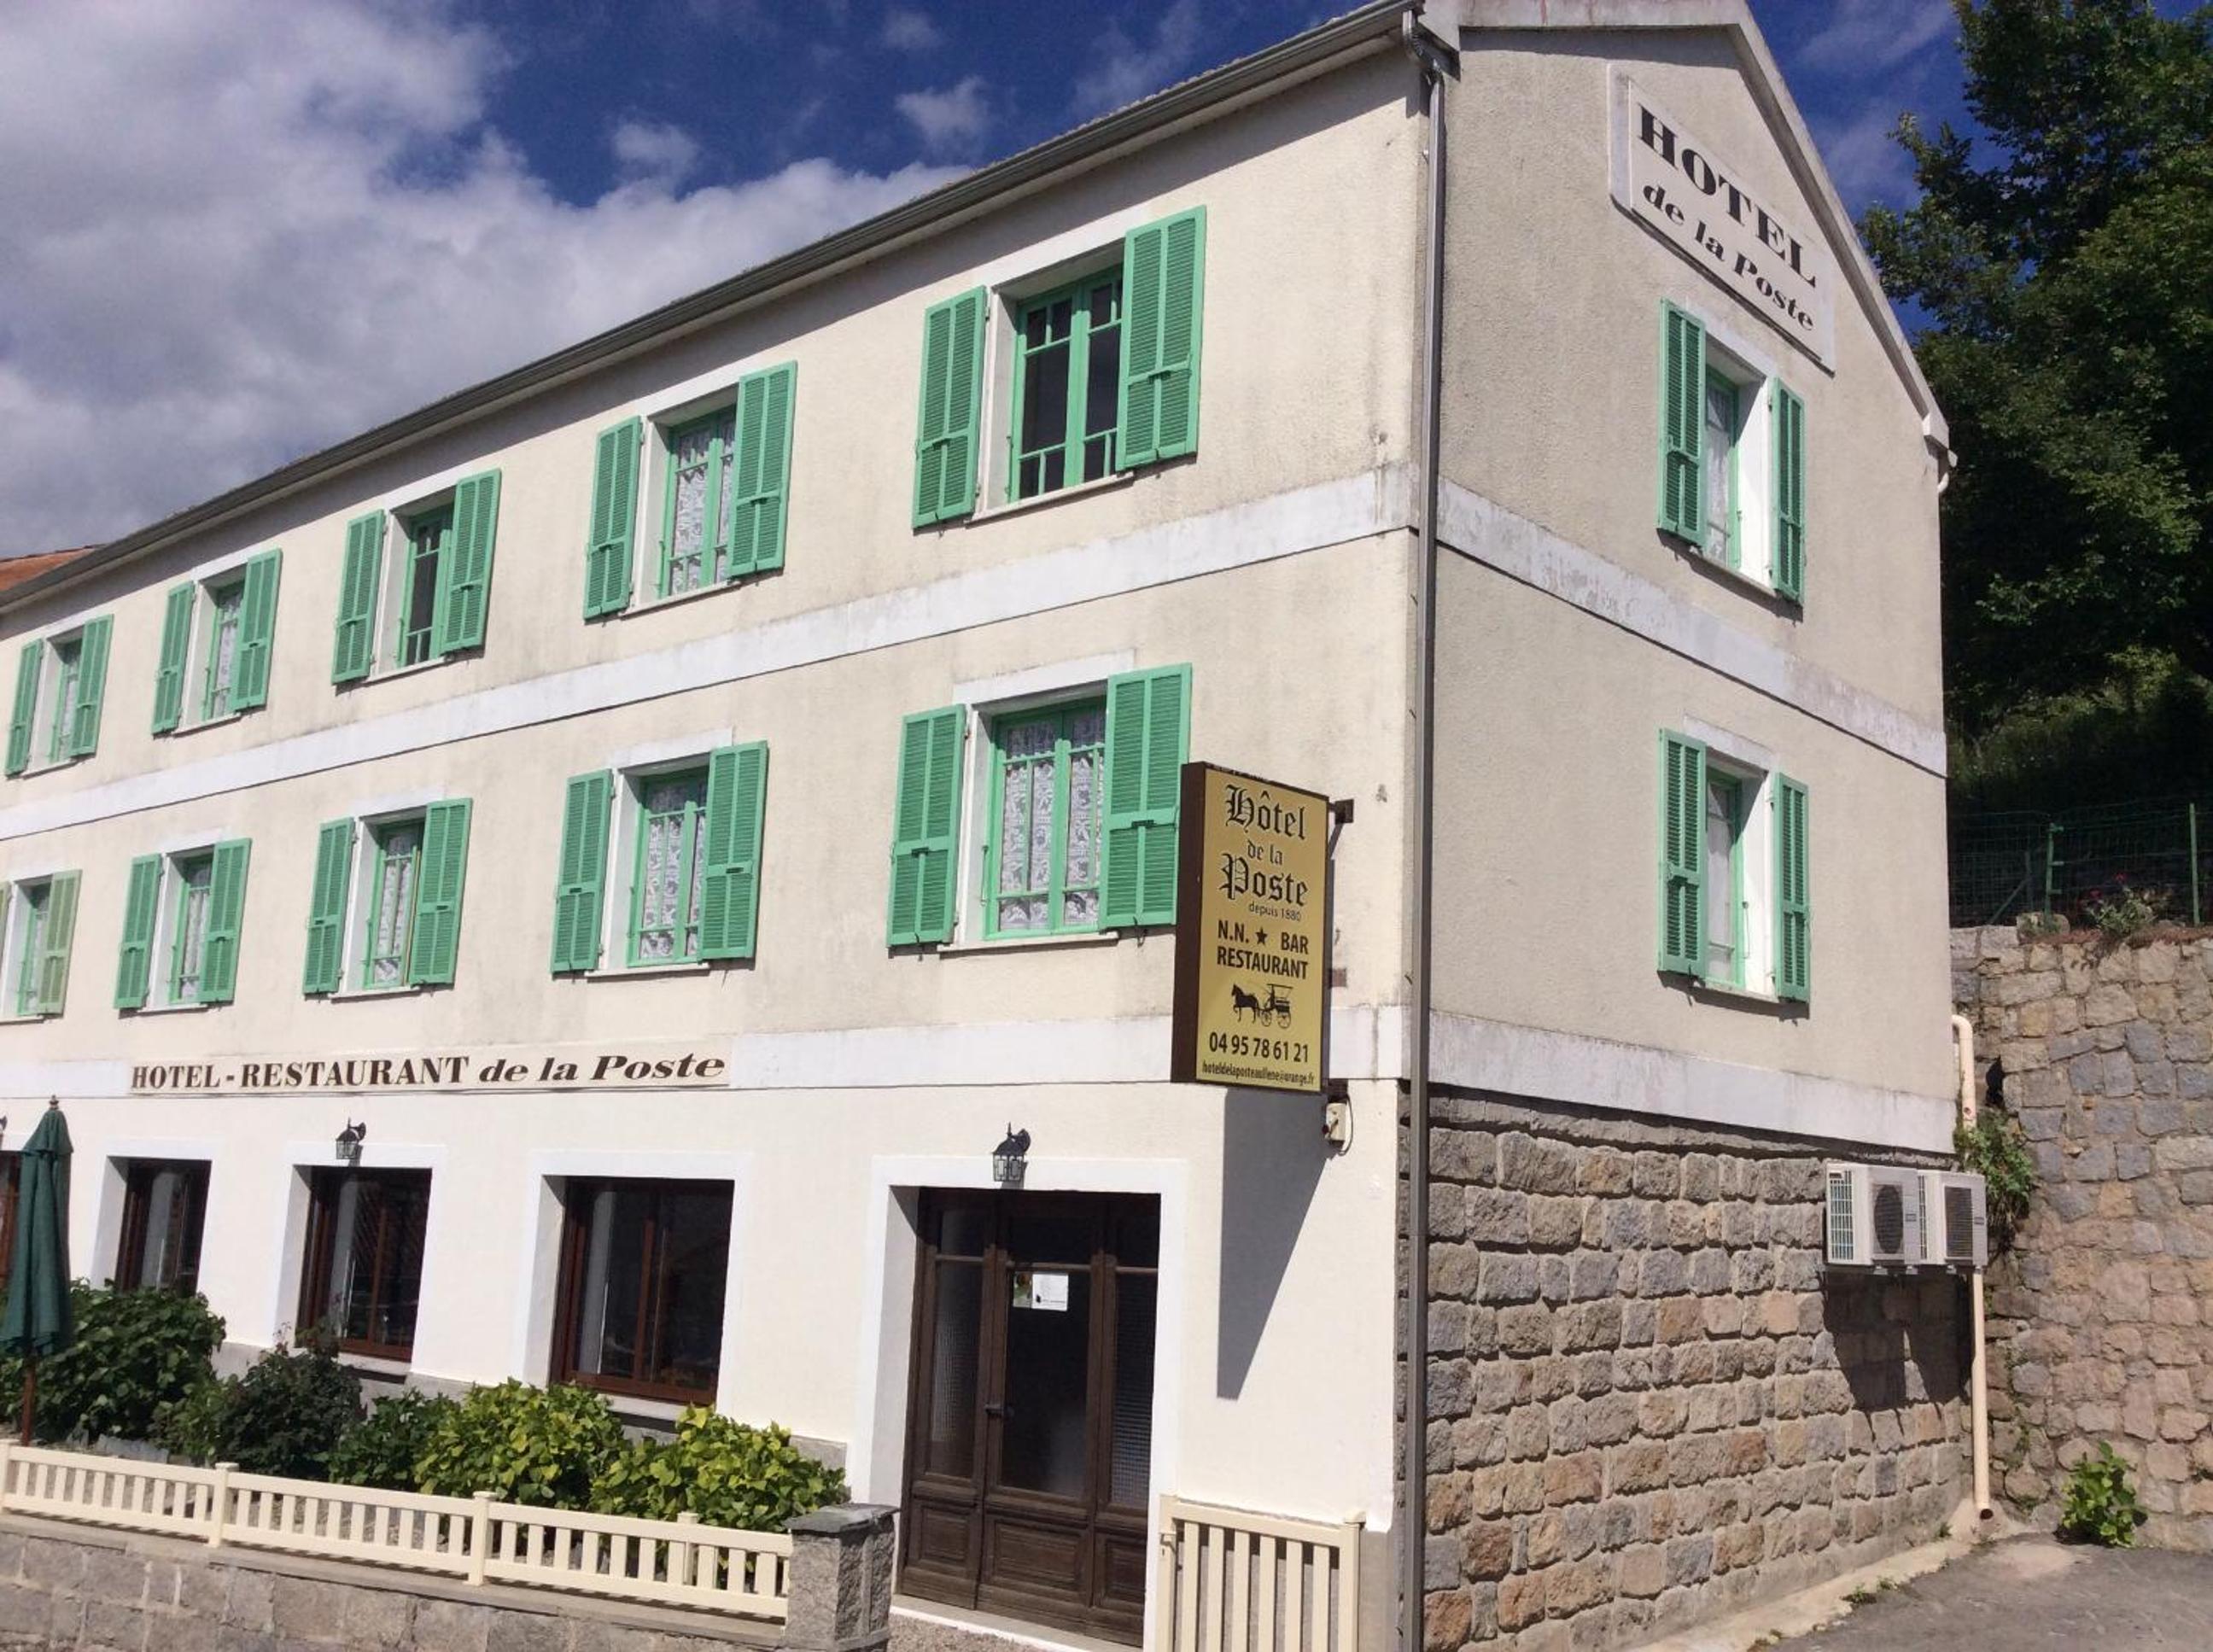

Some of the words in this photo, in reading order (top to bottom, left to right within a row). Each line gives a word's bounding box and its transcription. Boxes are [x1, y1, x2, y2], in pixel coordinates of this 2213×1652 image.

[1638, 103, 1815, 288] HOTEL
[1644, 184, 1685, 225] de
[1695, 219, 1725, 261] la
[1735, 253, 1814, 331] Poste
[1225, 784, 1305, 840] Hôtel
[1247, 839, 1264, 861] de
[1270, 844, 1282, 865] la
[1219, 854, 1308, 907] Poste
[1248, 901, 1278, 917] depuis
[1281, 908, 1301, 921] 1880
[1217, 919, 1248, 943] N.N.
[1281, 932, 1308, 955] BAR
[1217, 947, 1308, 979] RESTAURANT
[1209, 1031, 1228, 1054] 04
[1231, 1036, 1248, 1055] 95
[1252, 1038, 1270, 1059] 78
[1273, 1041, 1289, 1061] 61
[1293, 1043, 1309, 1063] 21
[478, 1059, 528, 1082] de
[537, 1057, 579, 1082] la
[589, 1053, 725, 1081] Poste
